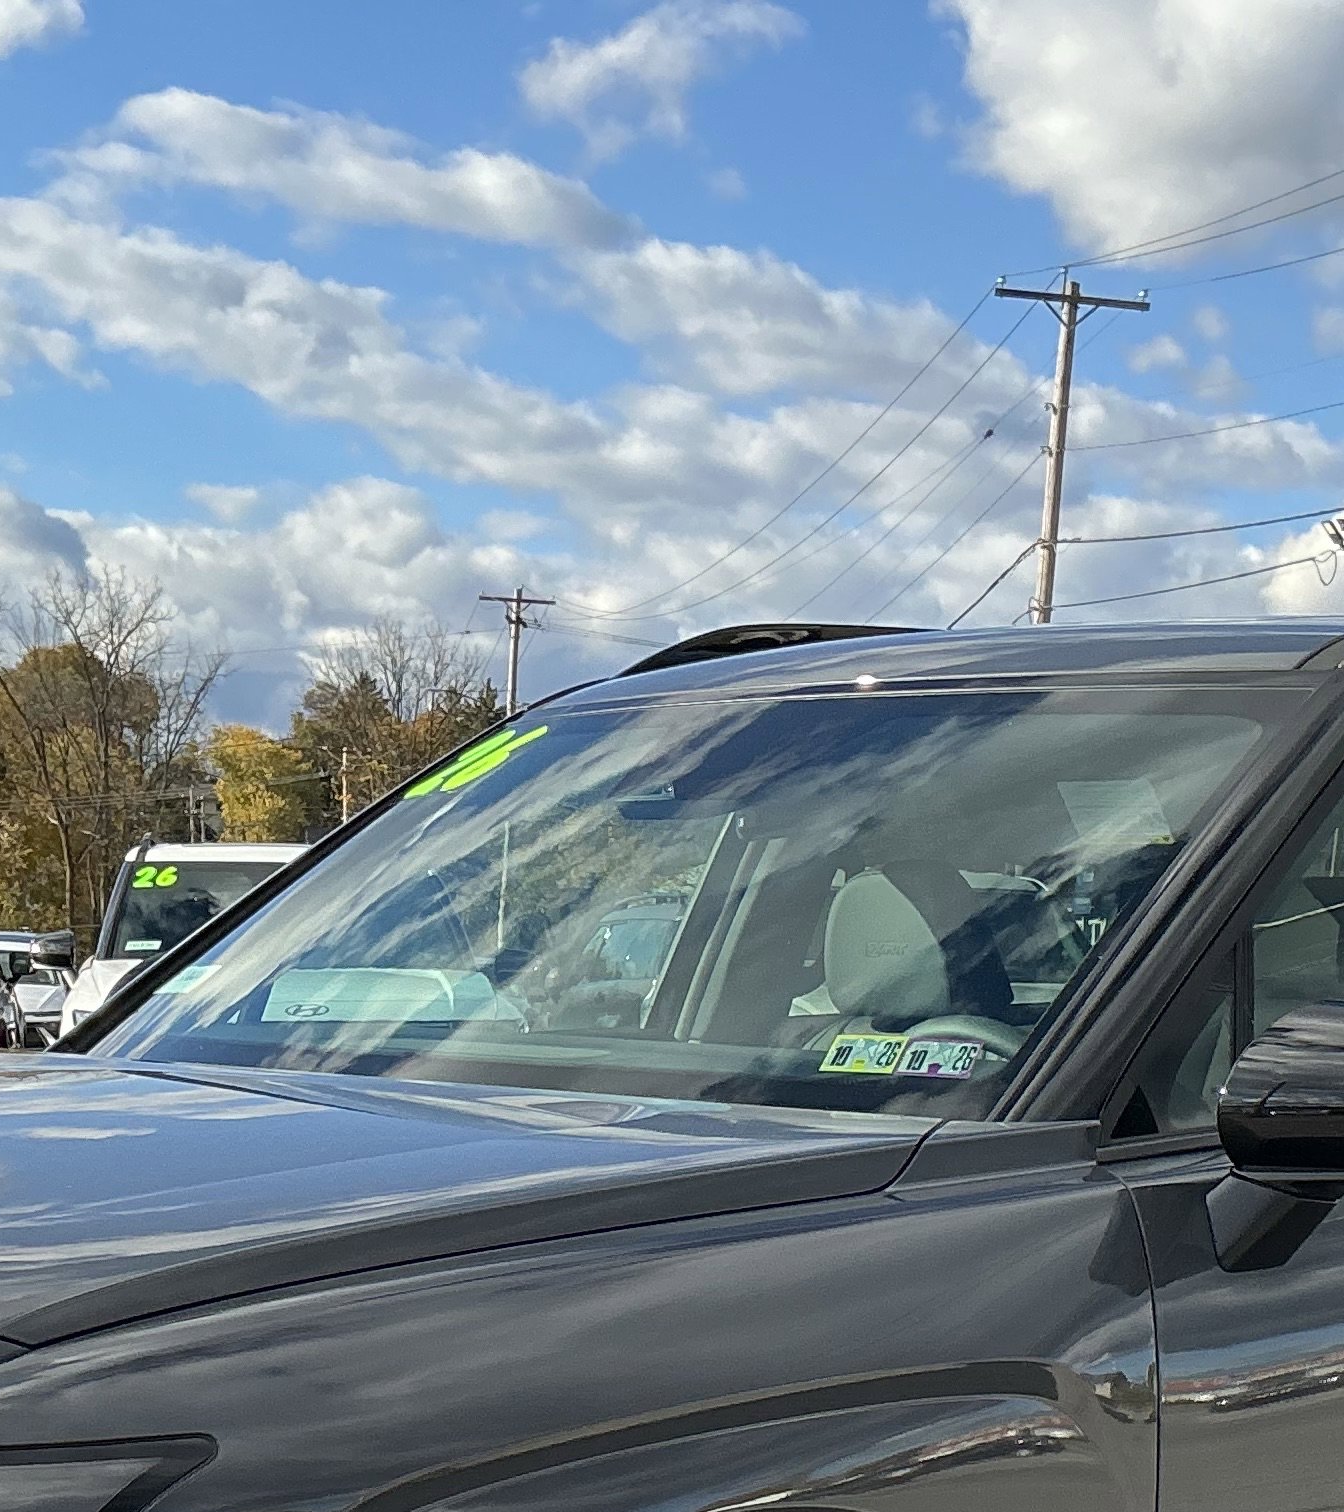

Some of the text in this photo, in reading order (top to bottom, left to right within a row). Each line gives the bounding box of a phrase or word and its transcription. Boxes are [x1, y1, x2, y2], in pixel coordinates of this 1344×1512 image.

[132, 865, 178, 888] 26
[829, 1041, 902, 1068] 10 26
[905, 1049, 929, 1071] 10
